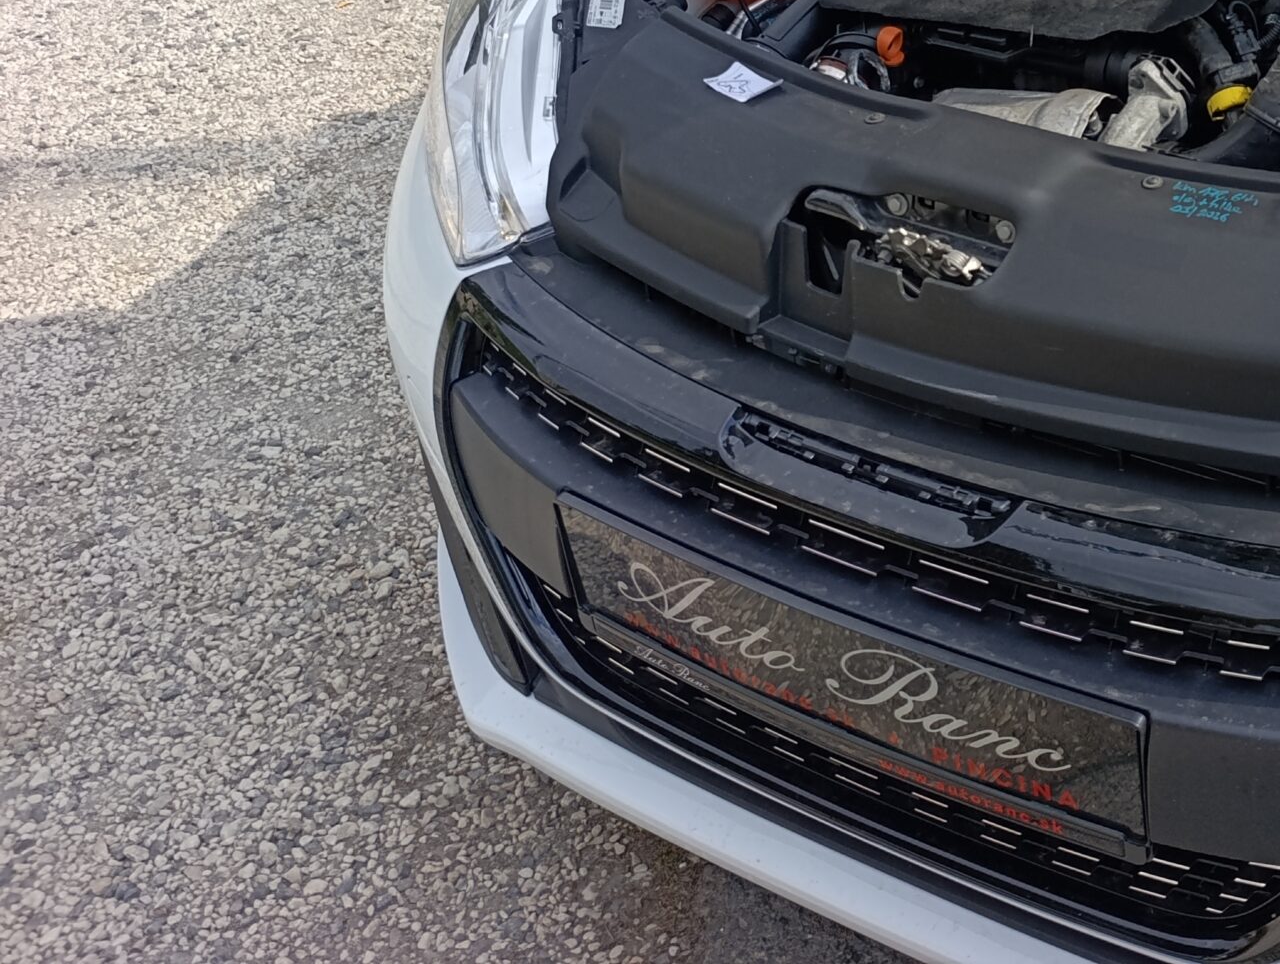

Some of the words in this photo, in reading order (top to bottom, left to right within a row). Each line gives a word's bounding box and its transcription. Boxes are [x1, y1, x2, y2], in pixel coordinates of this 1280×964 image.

[617, 561, 806, 671] Auto
[825, 648, 1072, 772] Ranc
[634, 645, 671, 670] Auto
[671, 663, 711, 691] Ranc
[879, 758, 1064, 835] www.autoranc.sk
